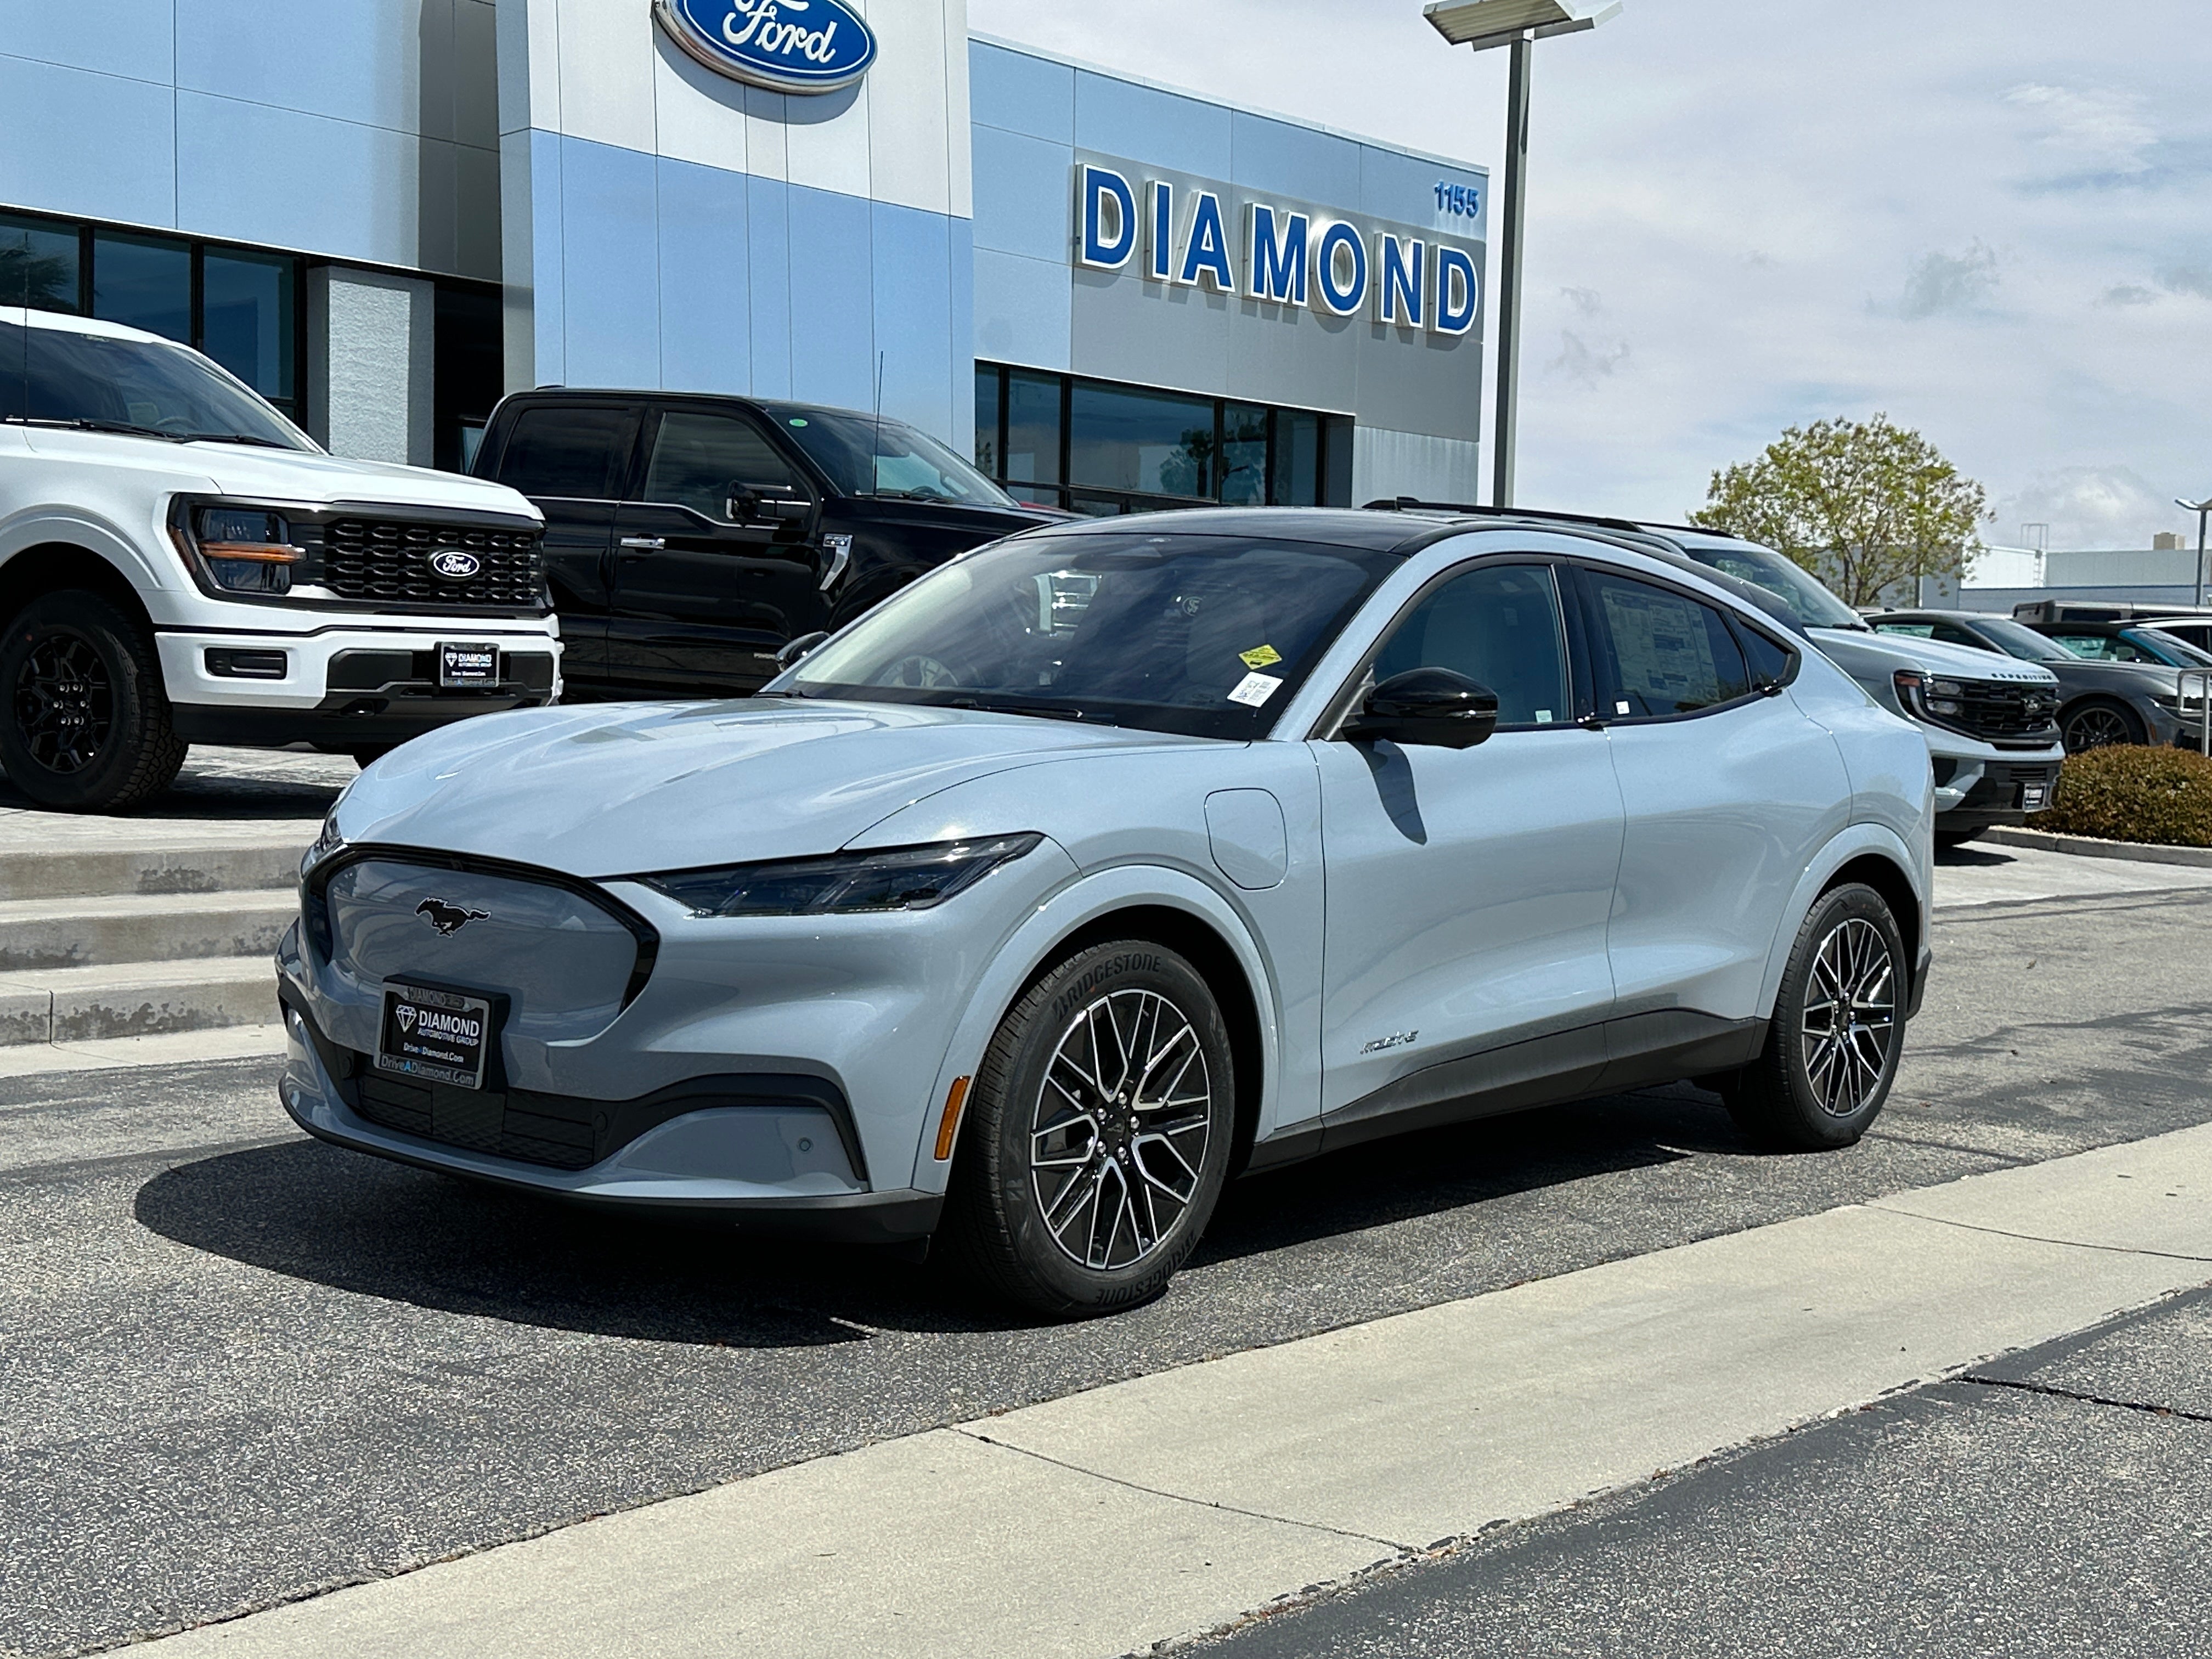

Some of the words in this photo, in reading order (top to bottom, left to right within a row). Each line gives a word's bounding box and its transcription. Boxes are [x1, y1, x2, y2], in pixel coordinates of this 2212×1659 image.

[723, 0, 837, 64] Ford
[1434, 179, 1479, 219] 1155
[1080, 163, 1479, 336] DIAMOND
[442, 555, 471, 573] Ford
[407, 988, 446, 1006] DIAMOND
[1052, 952, 1161, 1022] BRIDGESTONE
[417, 1027, 456, 1042] AUTOMOTIVE
[456, 1035, 479, 1047] GROUP
[419, 1010, 479, 1037] DIAMOND
[381, 1054, 475, 1086] DriveADiamond.Com
